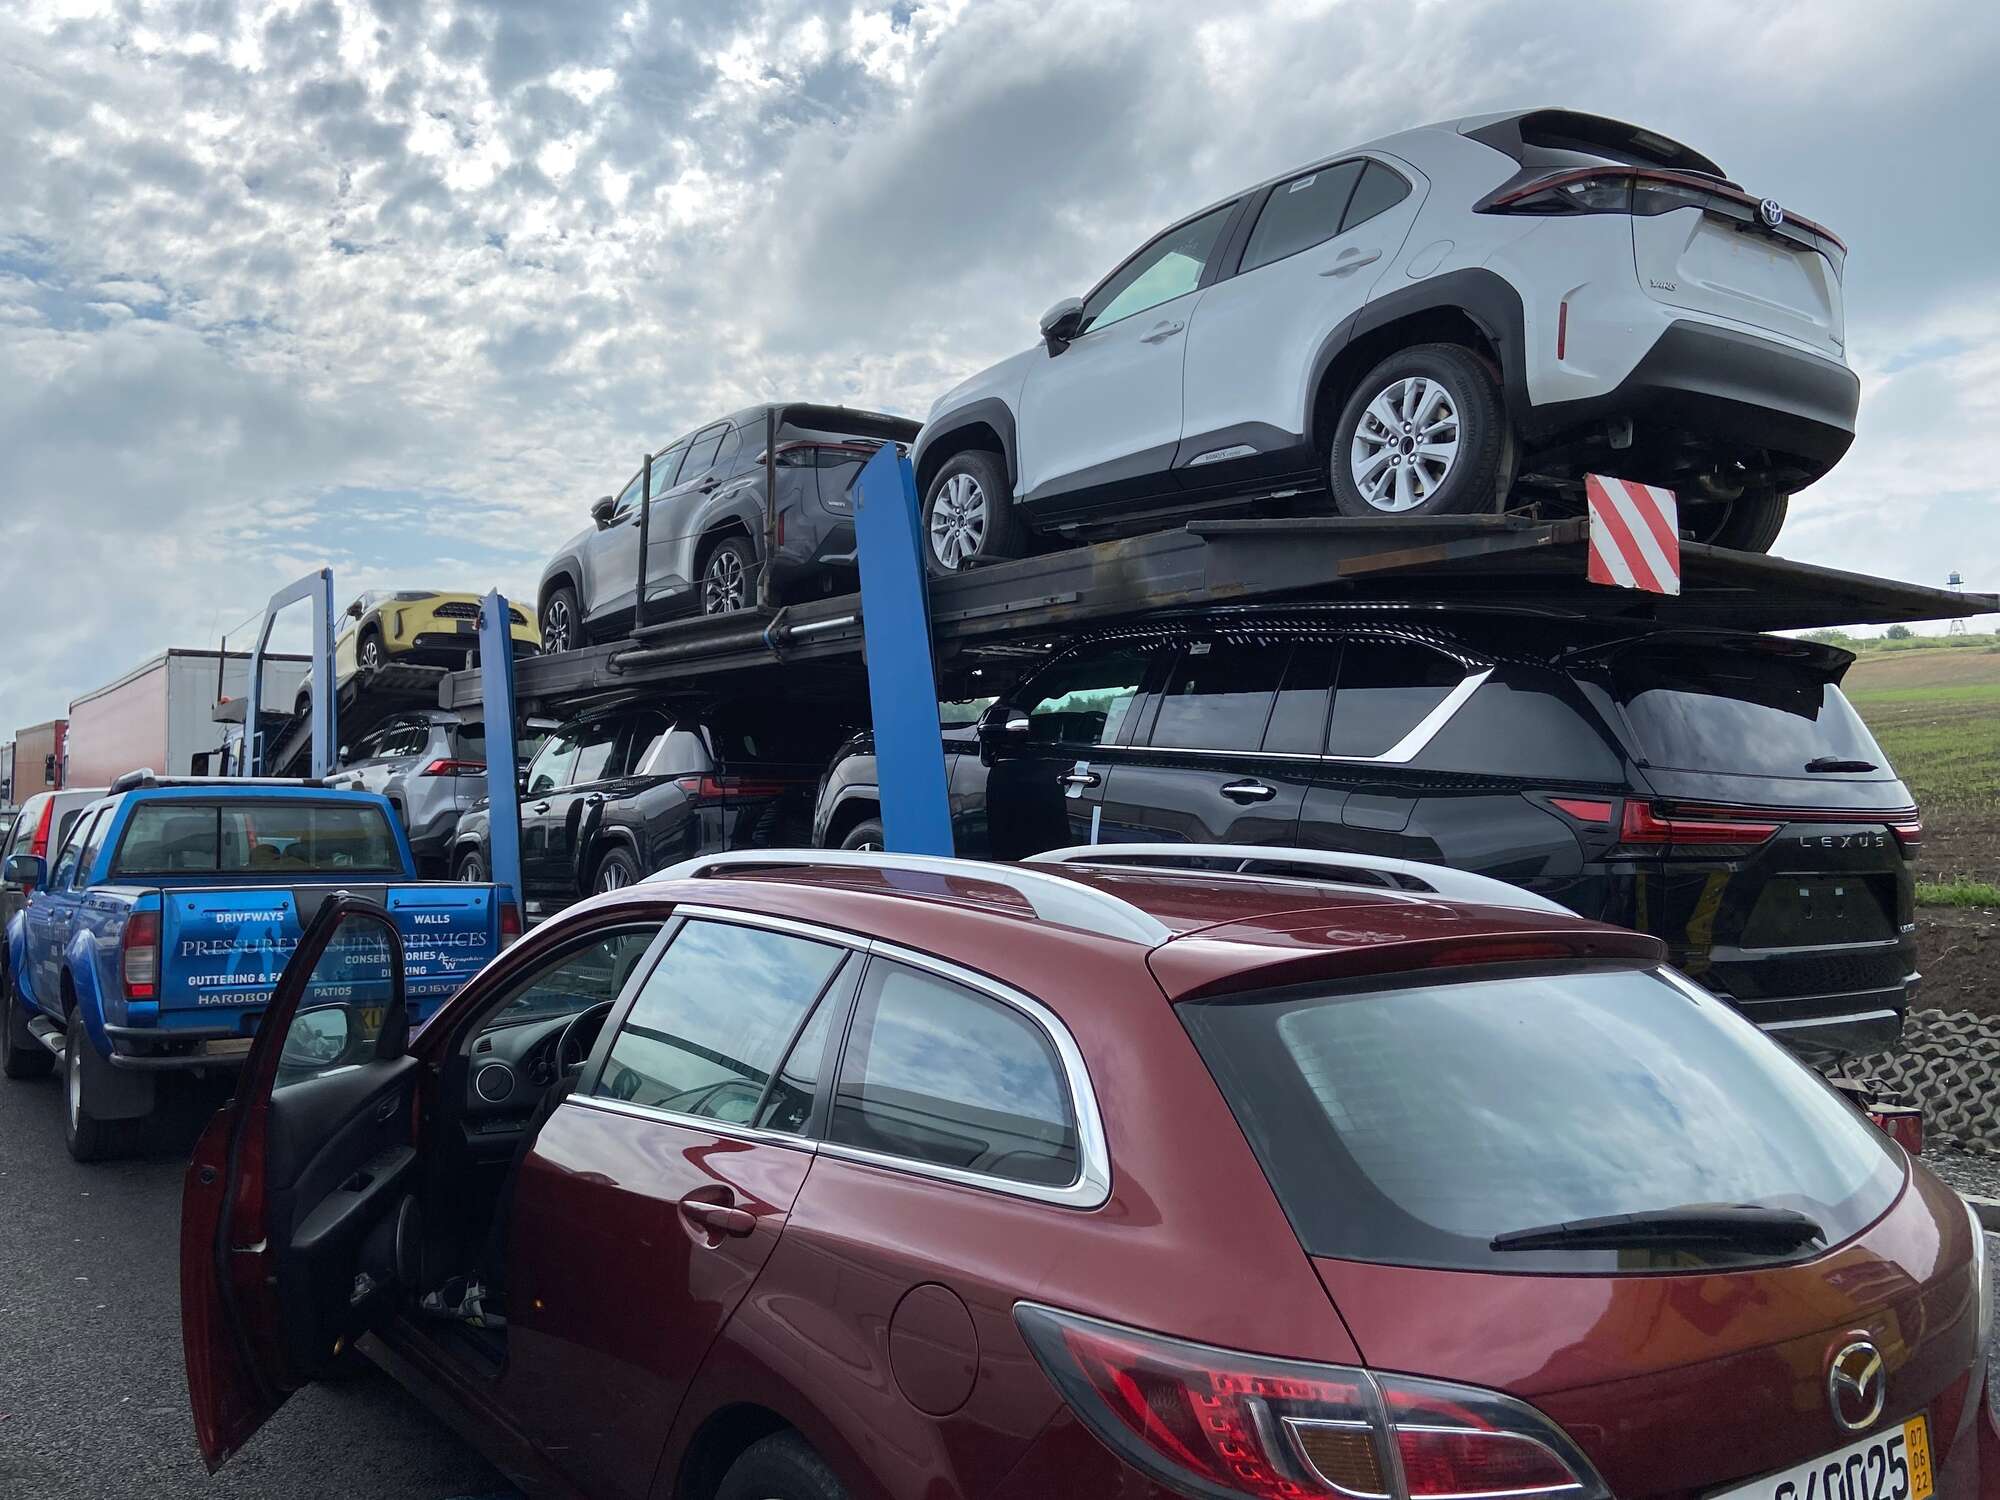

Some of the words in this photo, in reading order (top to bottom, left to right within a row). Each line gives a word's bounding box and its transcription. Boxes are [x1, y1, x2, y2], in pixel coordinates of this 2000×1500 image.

[1799, 836, 1885, 848] LEXUS
[216, 911, 285, 923] DRIVEWAYS
[414, 914, 451, 924] WALLS
[181, 937, 288, 957] PRESSURE
[401, 931, 487, 949] SERVICES
[188, 973, 256, 986] GUTTERING
[258, 973, 267, 983] &
[198, 991, 274, 1005] HARDBO
[313, 986, 352, 998] PATIOS
[1911, 1427, 1923, 1447] 07
[1913, 1449, 1926, 1470] 06
[1774, 1434, 1910, 1500] 0025
[1915, 1471, 1929, 1492] 22
